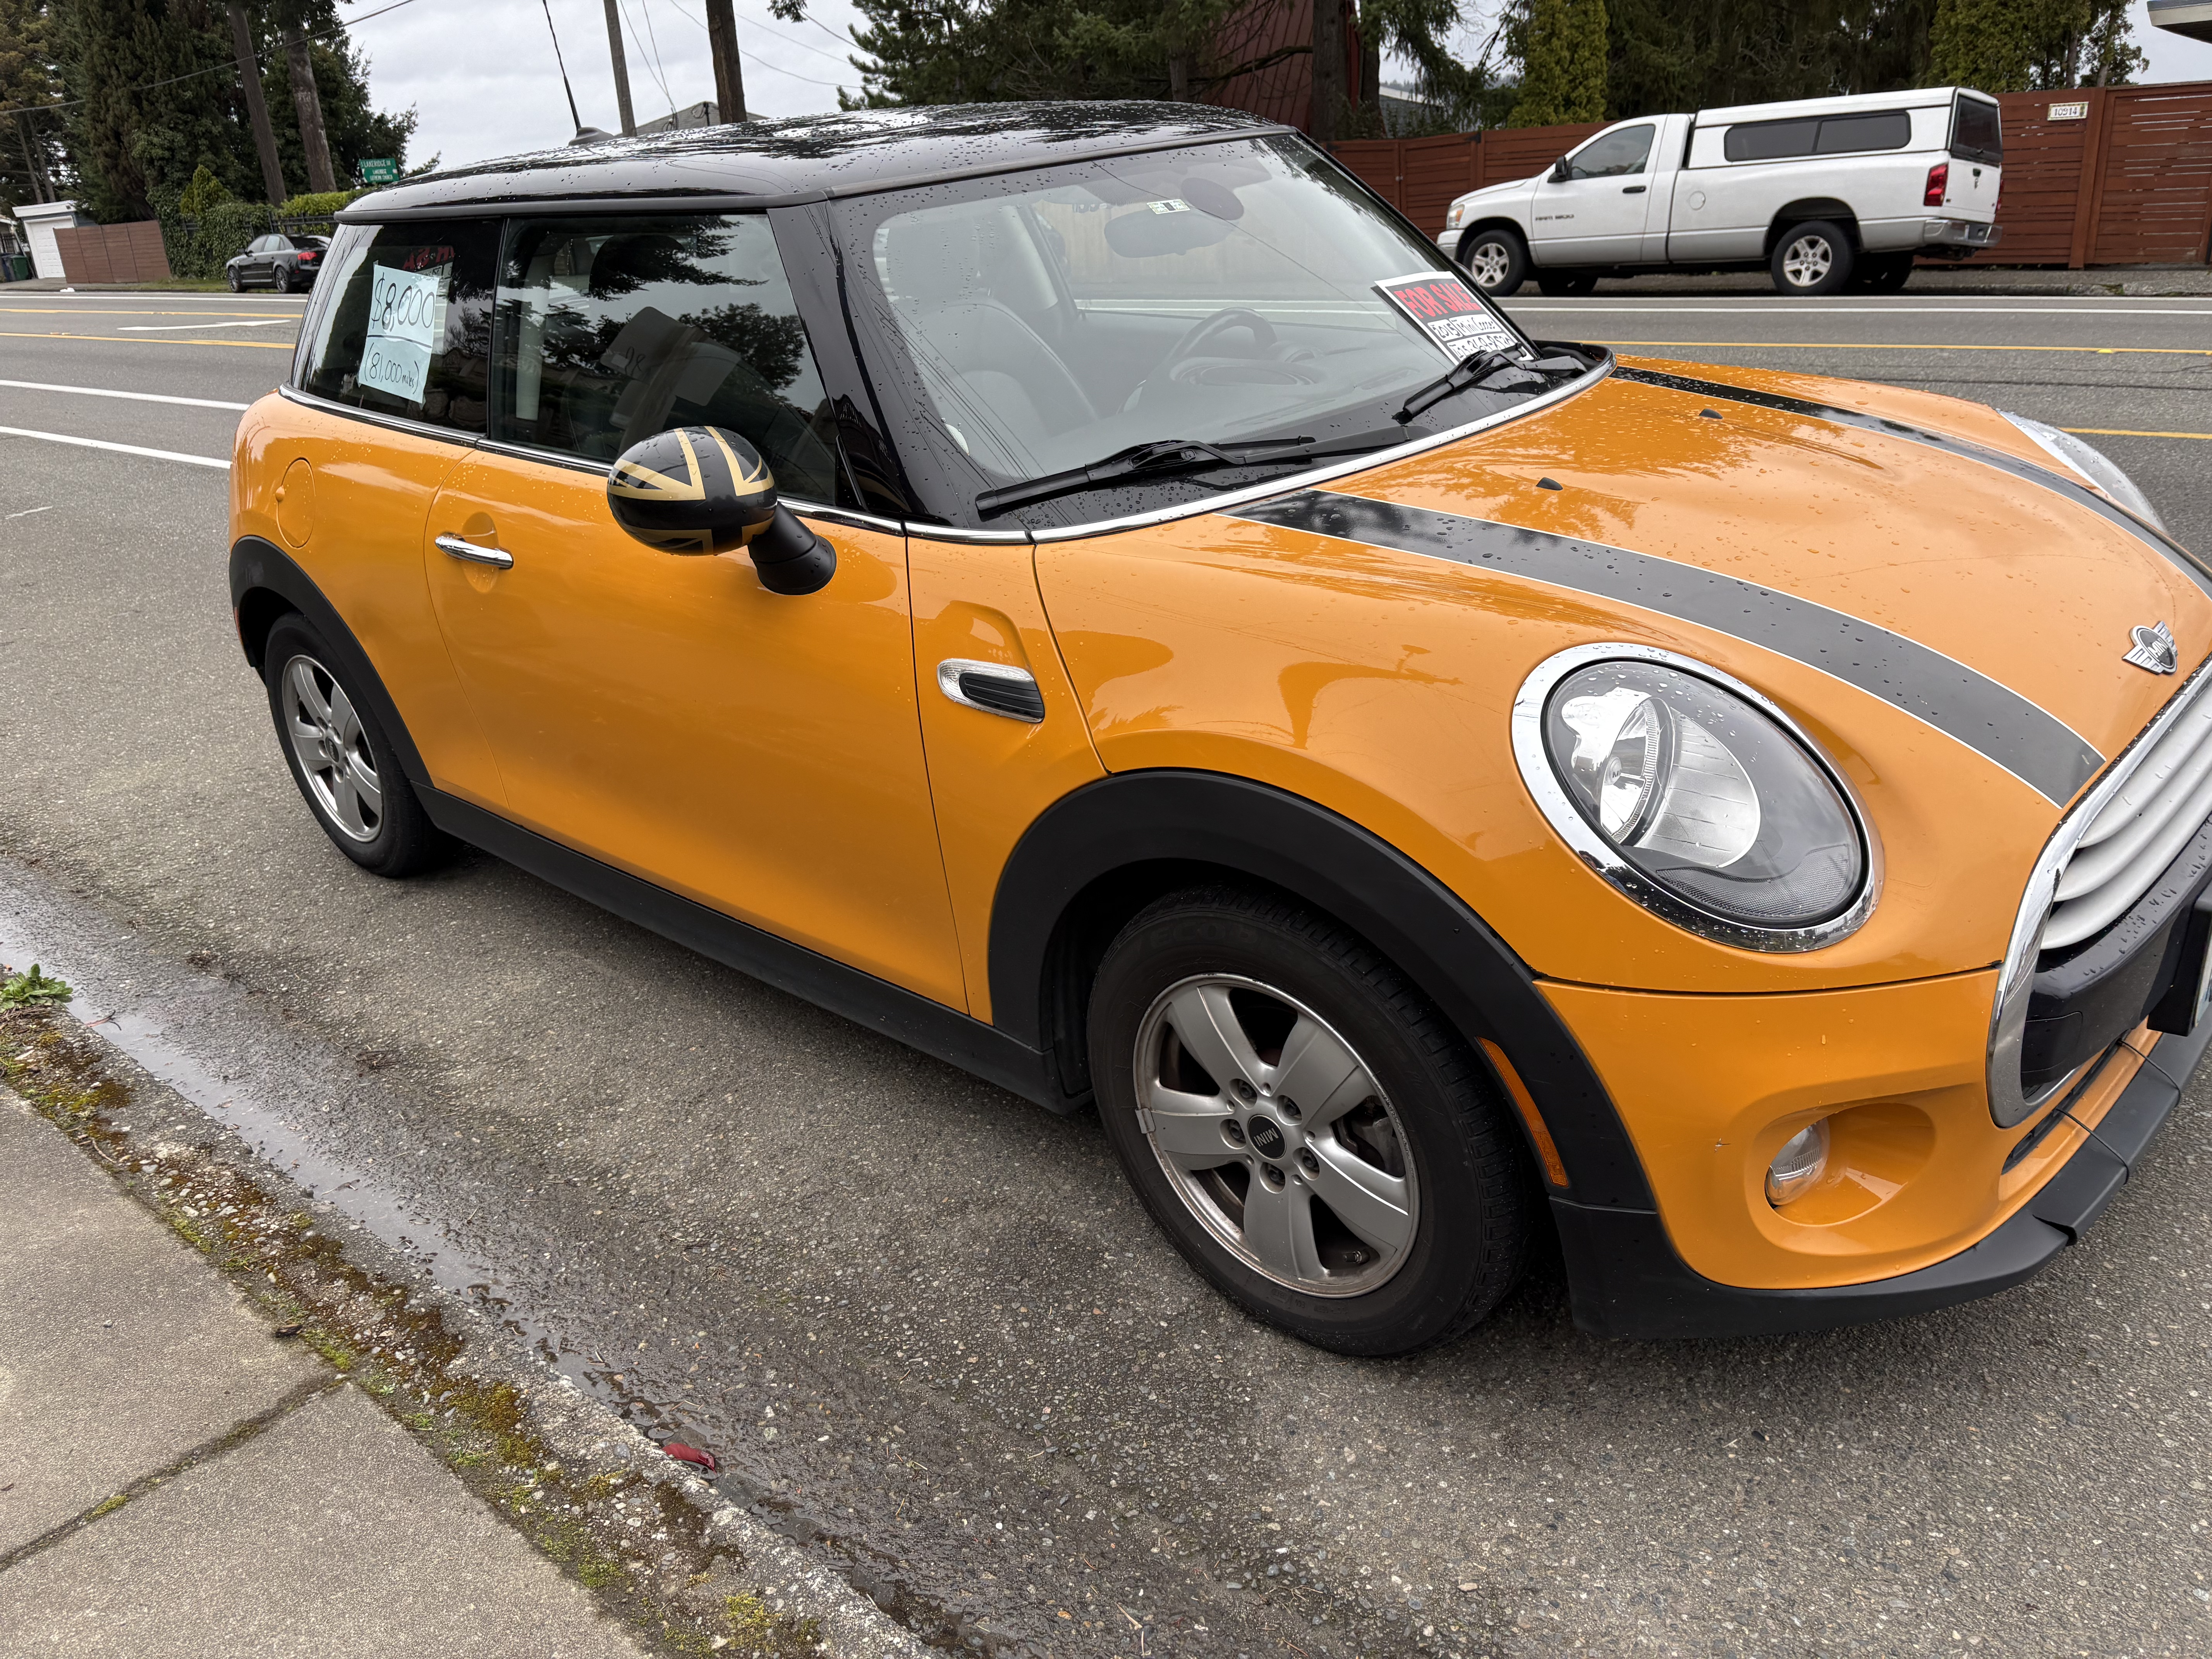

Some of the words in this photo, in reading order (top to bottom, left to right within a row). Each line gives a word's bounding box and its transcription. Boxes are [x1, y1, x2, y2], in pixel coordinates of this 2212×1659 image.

[2054, 107, 2077, 116] 10914
[371, 272, 435, 332] $8,000
[1394, 287, 1448, 319] FOR
[1429, 283, 1482, 312] SALE
[1432, 323, 1461, 338] 2015
[2147, 637, 2169, 658] MINI
[1254, 1128, 1279, 1147] MINI
